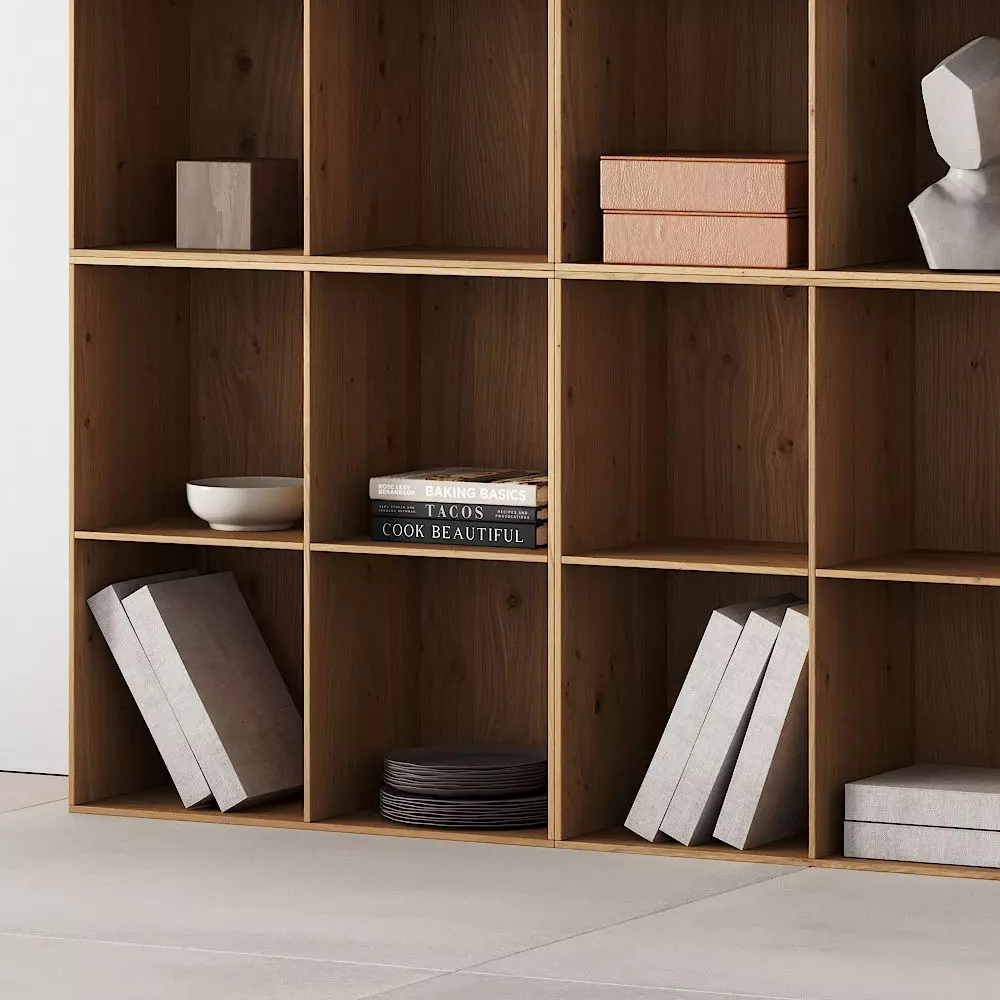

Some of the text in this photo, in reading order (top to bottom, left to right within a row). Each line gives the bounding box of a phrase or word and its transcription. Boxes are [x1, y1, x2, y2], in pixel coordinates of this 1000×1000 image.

[425, 485, 527, 502] BAKING BASICS
[425, 503, 484, 519] TACOS
[382, 522, 524, 543] COOK BEAUTIFUL
